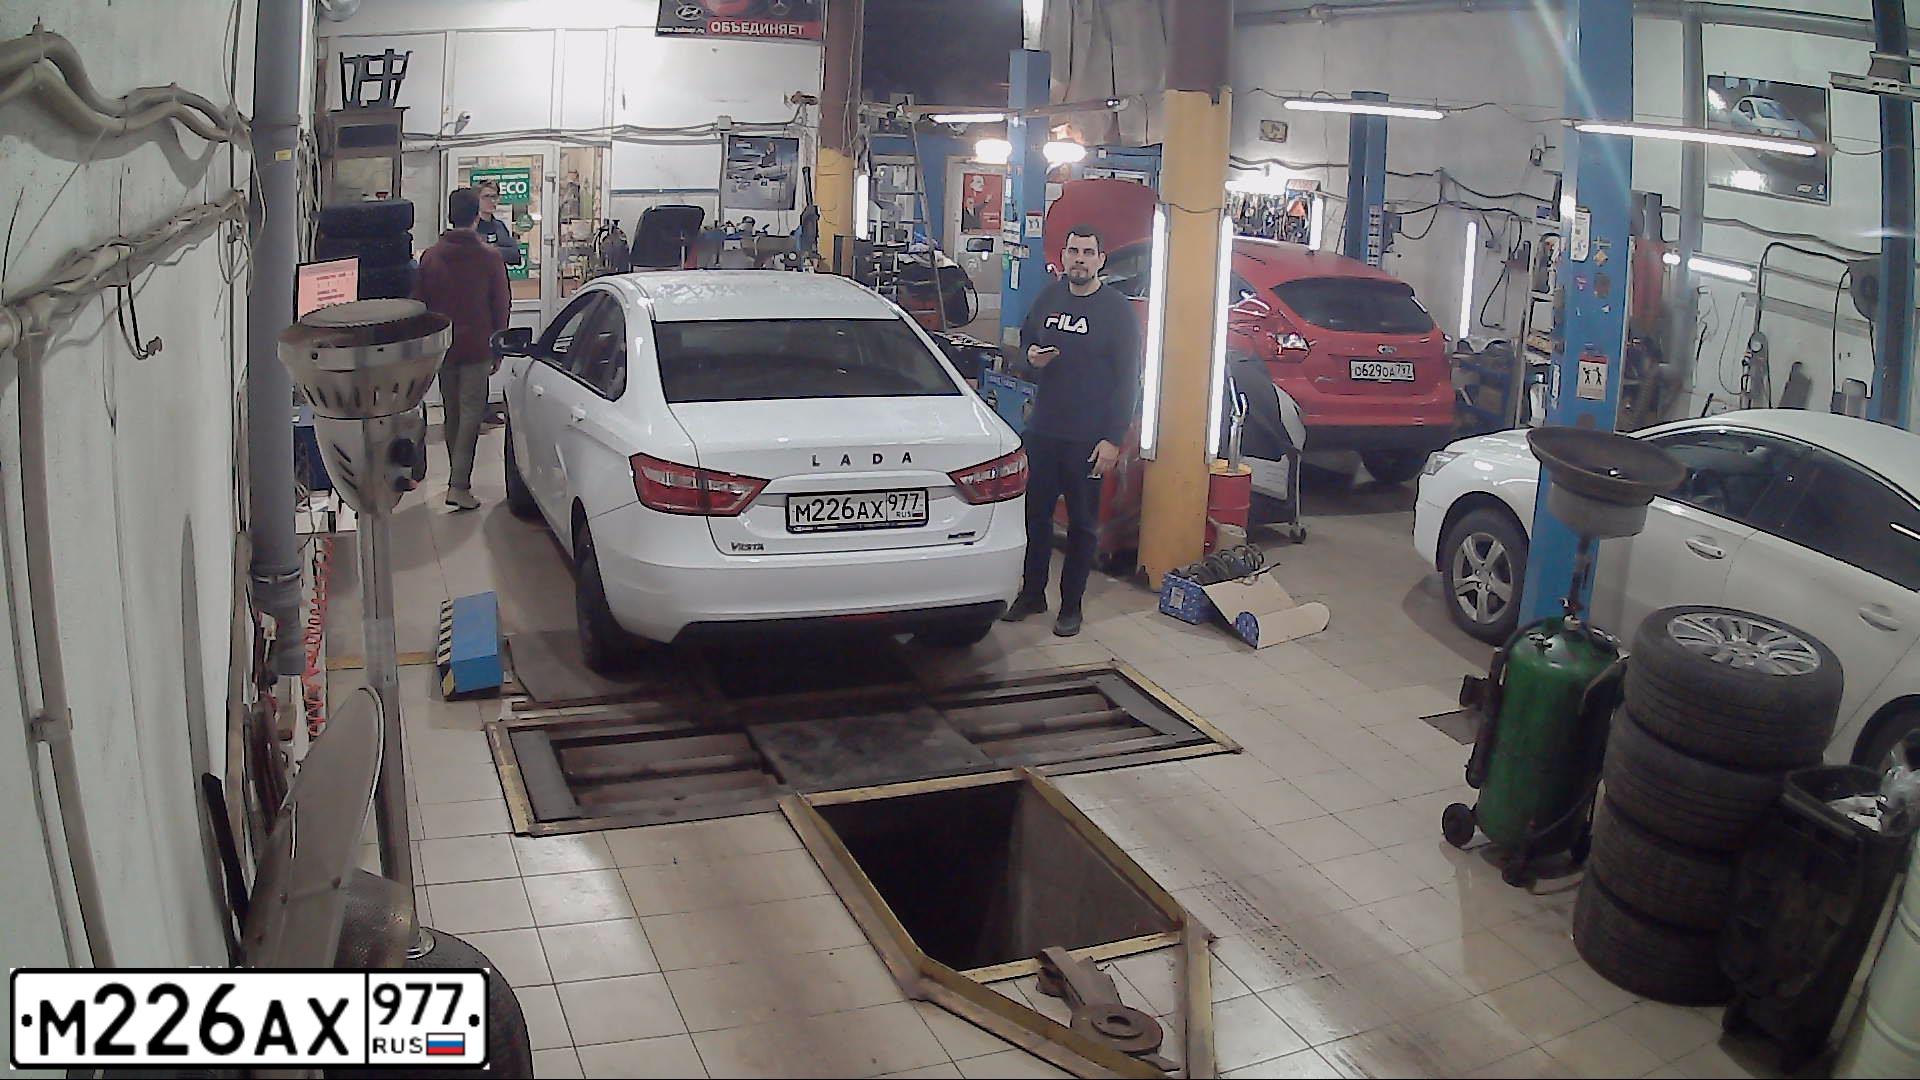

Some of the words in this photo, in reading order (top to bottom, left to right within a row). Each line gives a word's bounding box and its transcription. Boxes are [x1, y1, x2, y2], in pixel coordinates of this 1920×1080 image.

[711, 21, 805, 36] ОБЪЕДИНЯЕТ
[1045, 313, 1088, 334] FILA
[812, 452, 912, 467] LADA
[888, 493, 920, 511] 977
